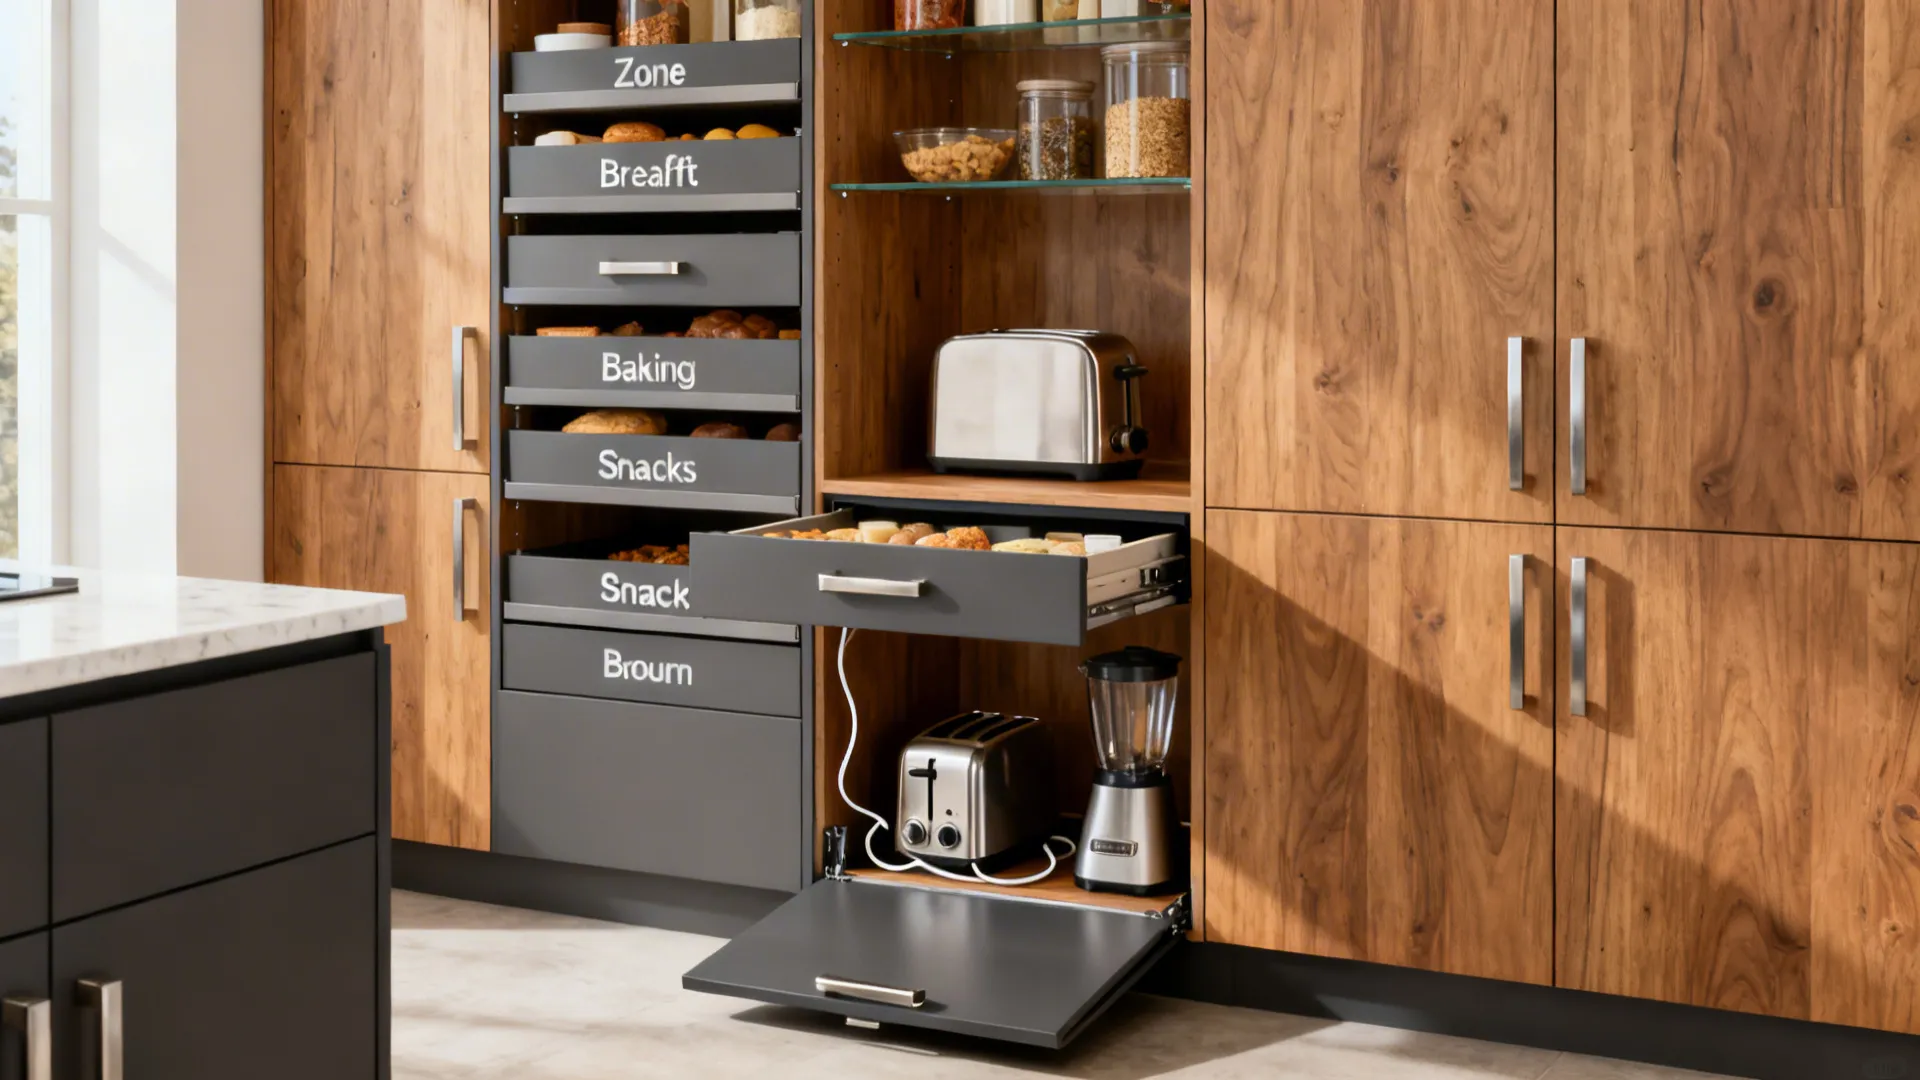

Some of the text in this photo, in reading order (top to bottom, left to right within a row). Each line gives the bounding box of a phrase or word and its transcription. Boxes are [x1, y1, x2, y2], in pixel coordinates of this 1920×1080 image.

[614, 57, 686, 88] Zone
[602, 352, 696, 390] Baking
[599, 449, 697, 483] Snacks
[601, 572, 690, 609] Snack
